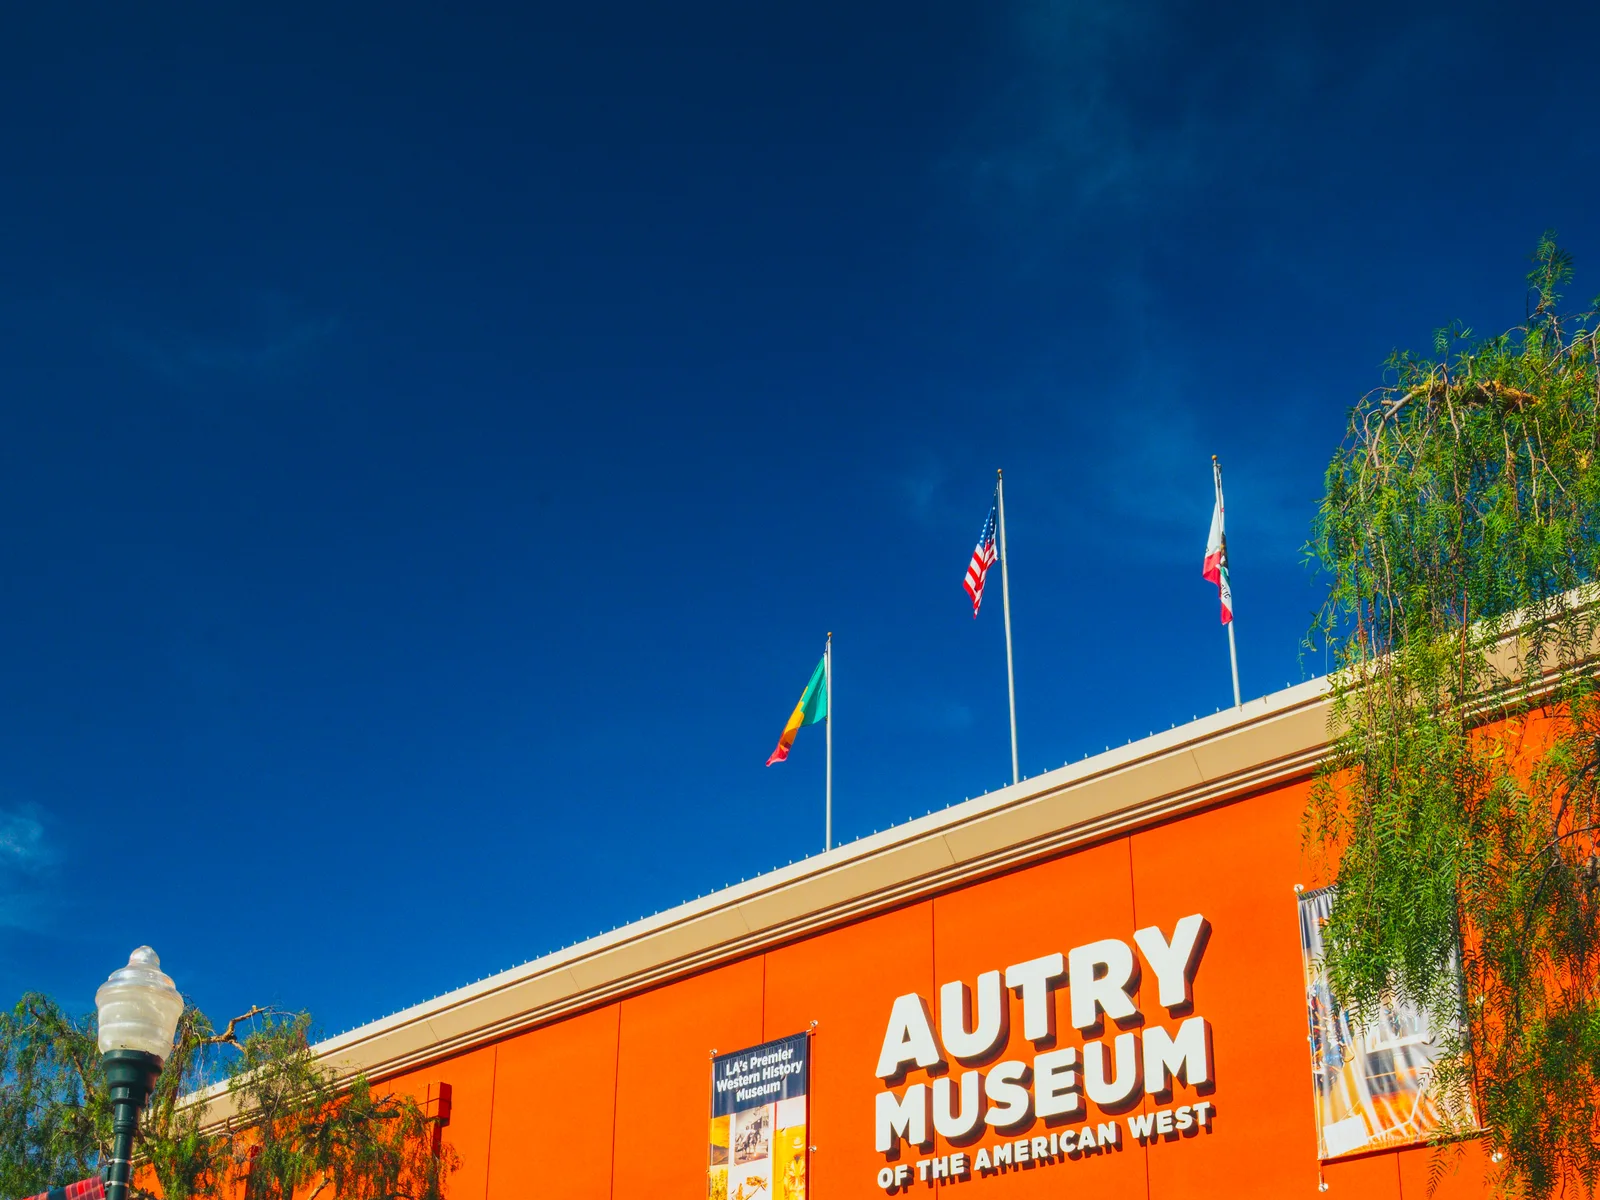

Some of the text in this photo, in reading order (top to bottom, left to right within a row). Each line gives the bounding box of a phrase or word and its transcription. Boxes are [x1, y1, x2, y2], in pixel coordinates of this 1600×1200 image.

[875, 913, 1208, 1081] AUTRY
[716, 1060, 803, 1092] Western History
[726, 1048, 793, 1076] LA's Premier
[736, 1080, 780, 1102] Museum
[875, 1016, 1210, 1155] MUSEUM
[877, 1101, 1213, 1189] OF THE AMERICAN WEST
